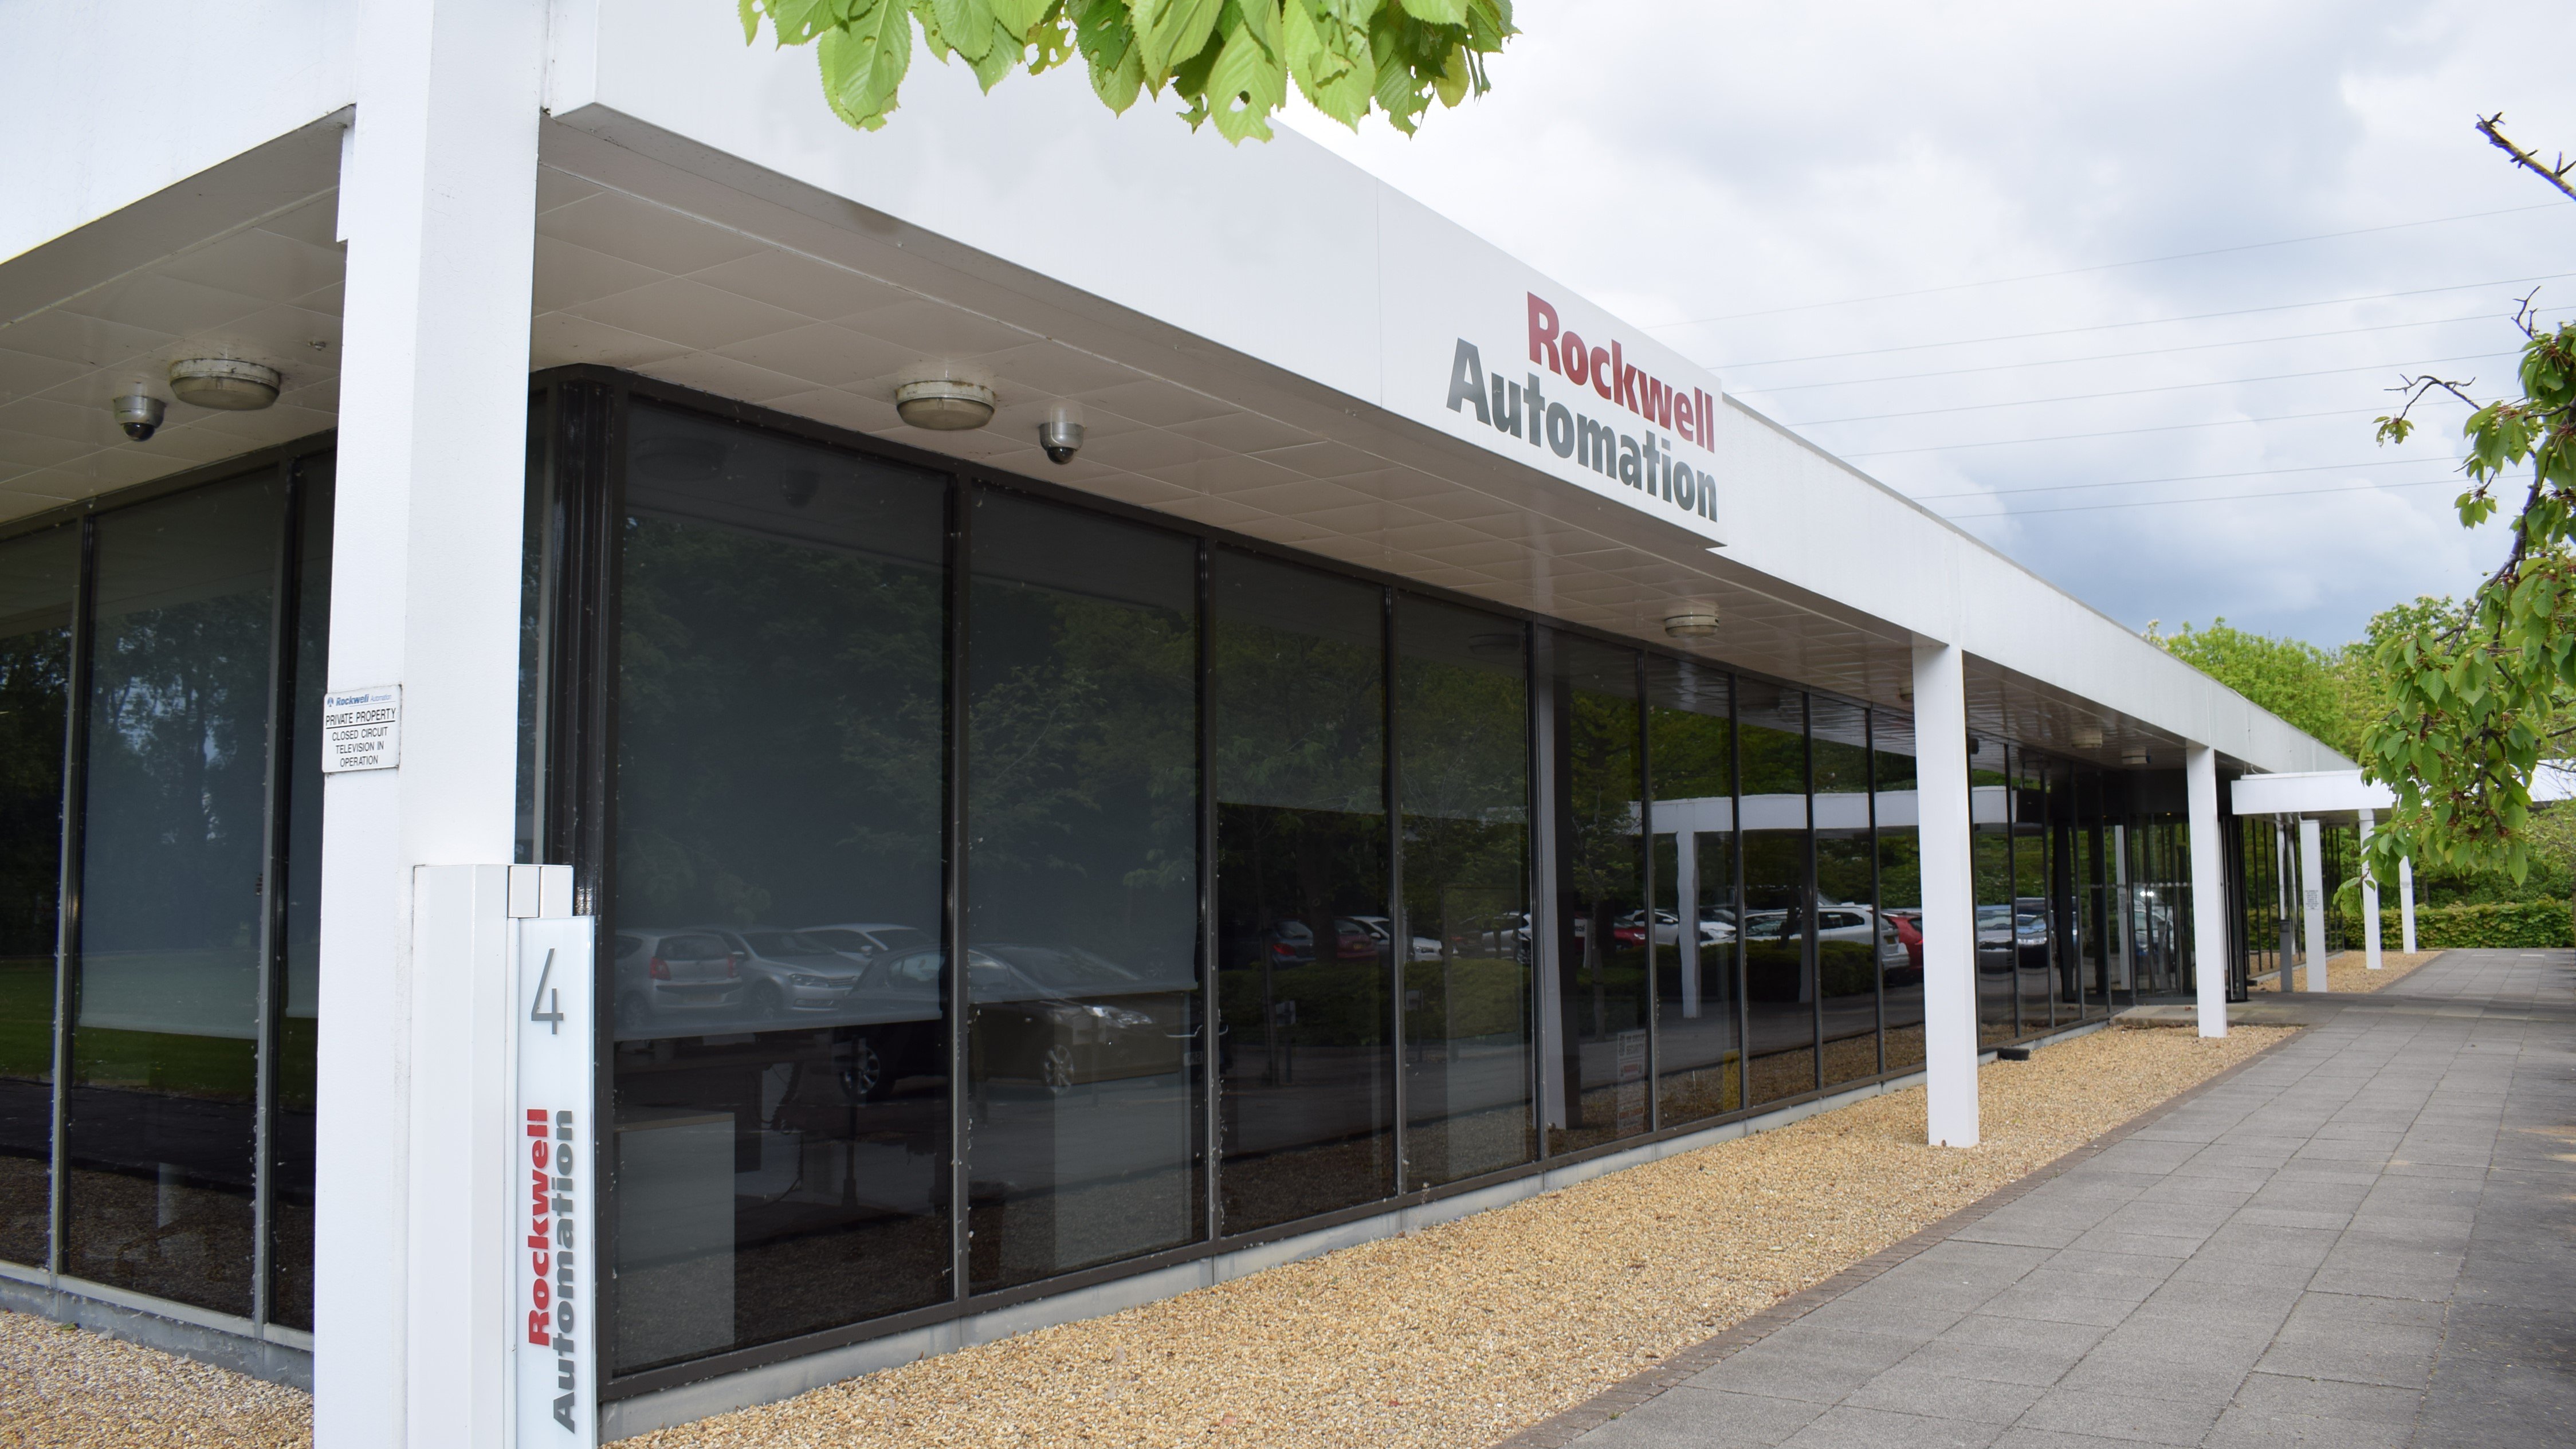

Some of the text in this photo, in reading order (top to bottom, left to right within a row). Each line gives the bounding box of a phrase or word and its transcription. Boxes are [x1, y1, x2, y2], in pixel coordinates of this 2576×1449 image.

[1527, 291, 1715, 454] Rockwell
[1446, 337, 1718, 523] Automation
[326, 708, 396, 726] PRIVATE PROPERTY
[336, 694, 369, 706] Rockwell
[332, 727, 388, 741] CLOSED CIRCUIT
[336, 741, 384, 754] TELEVISION IN
[340, 755, 379, 767] OPERATION
[531, 948, 564, 1035] 4
[527, 1109, 550, 1346] Rockwell
[551, 1110, 575, 1434] Automation
